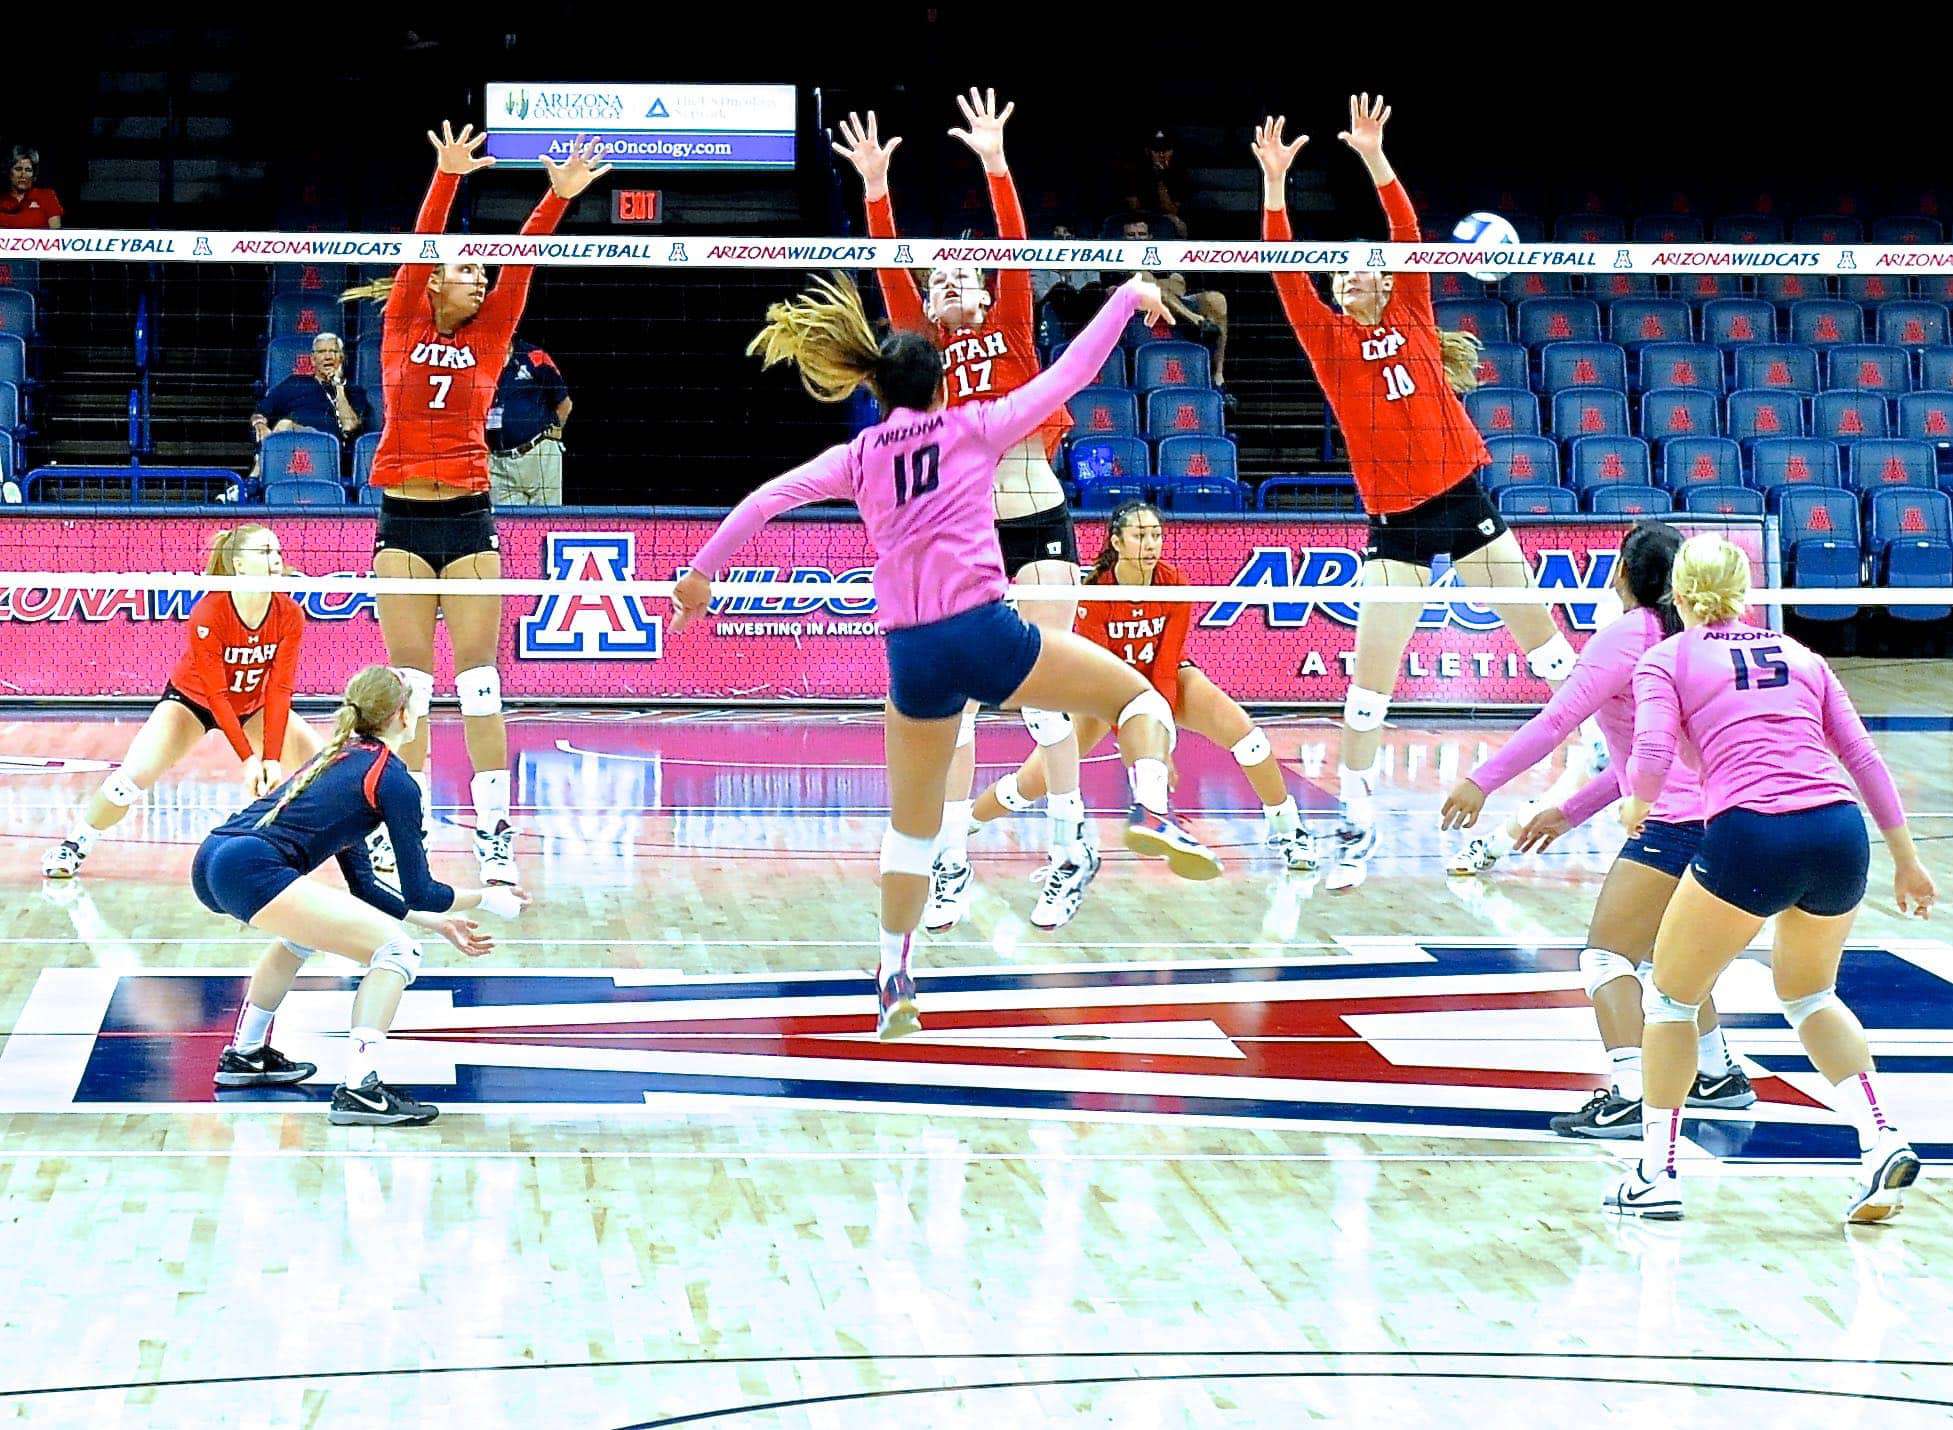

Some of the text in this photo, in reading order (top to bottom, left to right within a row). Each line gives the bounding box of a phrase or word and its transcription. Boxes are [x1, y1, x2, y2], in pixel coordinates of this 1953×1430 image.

[533, 92, 624, 109] ARIZONA
[620, 191, 655, 220] EXIT
[231, 240, 402, 256] ARIZONAWILDCATS
[458, 243, 651, 259] ARIZONAVOLLEYBALL
[706, 246, 877, 261] ARIZONAWILDCATS
[932, 247, 1125, 263] ARIZONAVOLLEYBALL
[1179, 250, 1350, 265] ARIZONAWILDCATS
[1405, 251, 1596, 266] ARIZONAVOLLEYBALL
[1652, 252, 1821, 267] ARIZONAWILDCATS
[410, 343, 476, 368] UTAH
[954, 360, 993, 397] 17
[428, 375, 453, 409] 7
[874, 415, 944, 448] ARIZONA
[894, 443, 941, 507] 10
[716, 622, 801, 635] INVESTING
[806, 622, 822, 635] IN
[1108, 616, 1166, 638] UTAH
[1703, 632, 1782, 641] ARIZONA
[224, 643, 277, 664] UTAH
[1123, 642, 1155, 664] 14
[229, 668, 264, 692] 15
[1730, 645, 1789, 691] 15
